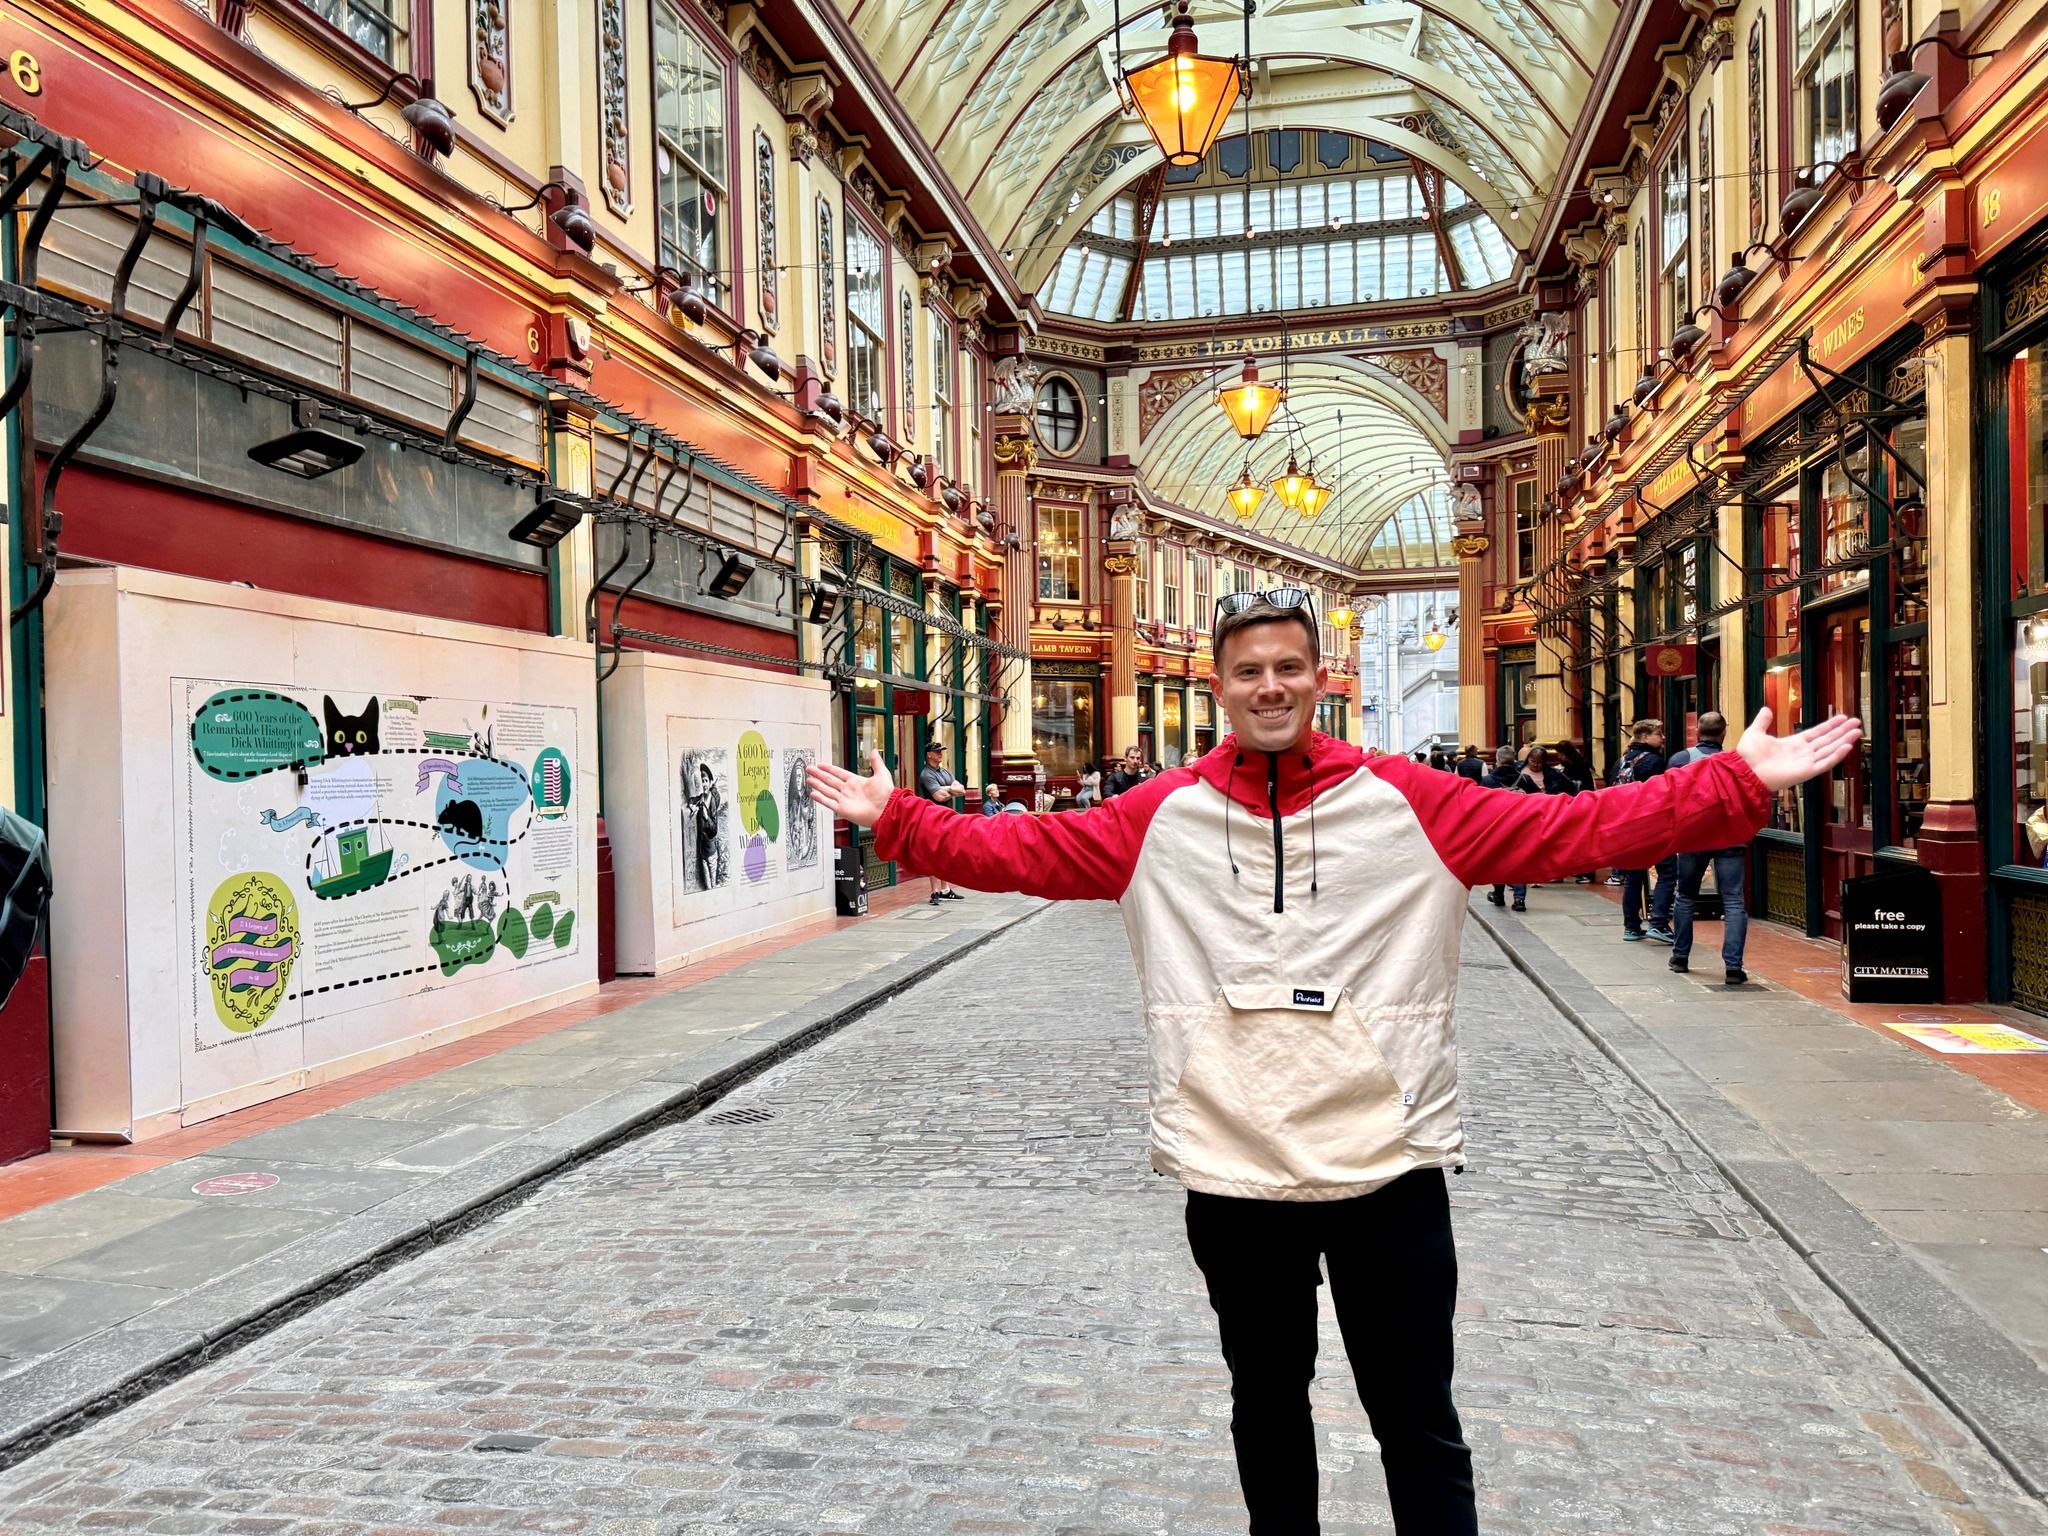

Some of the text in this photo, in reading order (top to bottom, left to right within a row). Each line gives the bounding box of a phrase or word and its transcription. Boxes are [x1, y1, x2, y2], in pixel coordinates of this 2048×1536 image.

[10, 49, 41, 95] 6
[1982, 188, 2001, 229] 18
[1822, 304, 1865, 360] WINES
[527, 327, 540, 354] 6
[1204, 328, 1378, 356] LEADENHALL
[1745, 400, 1754, 424] 19
[1032, 644, 1092, 654] LAMB TAVERN
[233, 711, 302, 724] 600 Years of the
[202, 722, 303, 738] Remarkable History of
[231, 736, 305, 751] Dick Whittington
[736, 743, 775, 759] A 600 Year
[743, 760, 769, 781] Legacy:
[1874, 908, 1906, 921] free
[1854, 923, 1880, 931] please
[1854, 966, 1929, 975] CITY MATTERS
